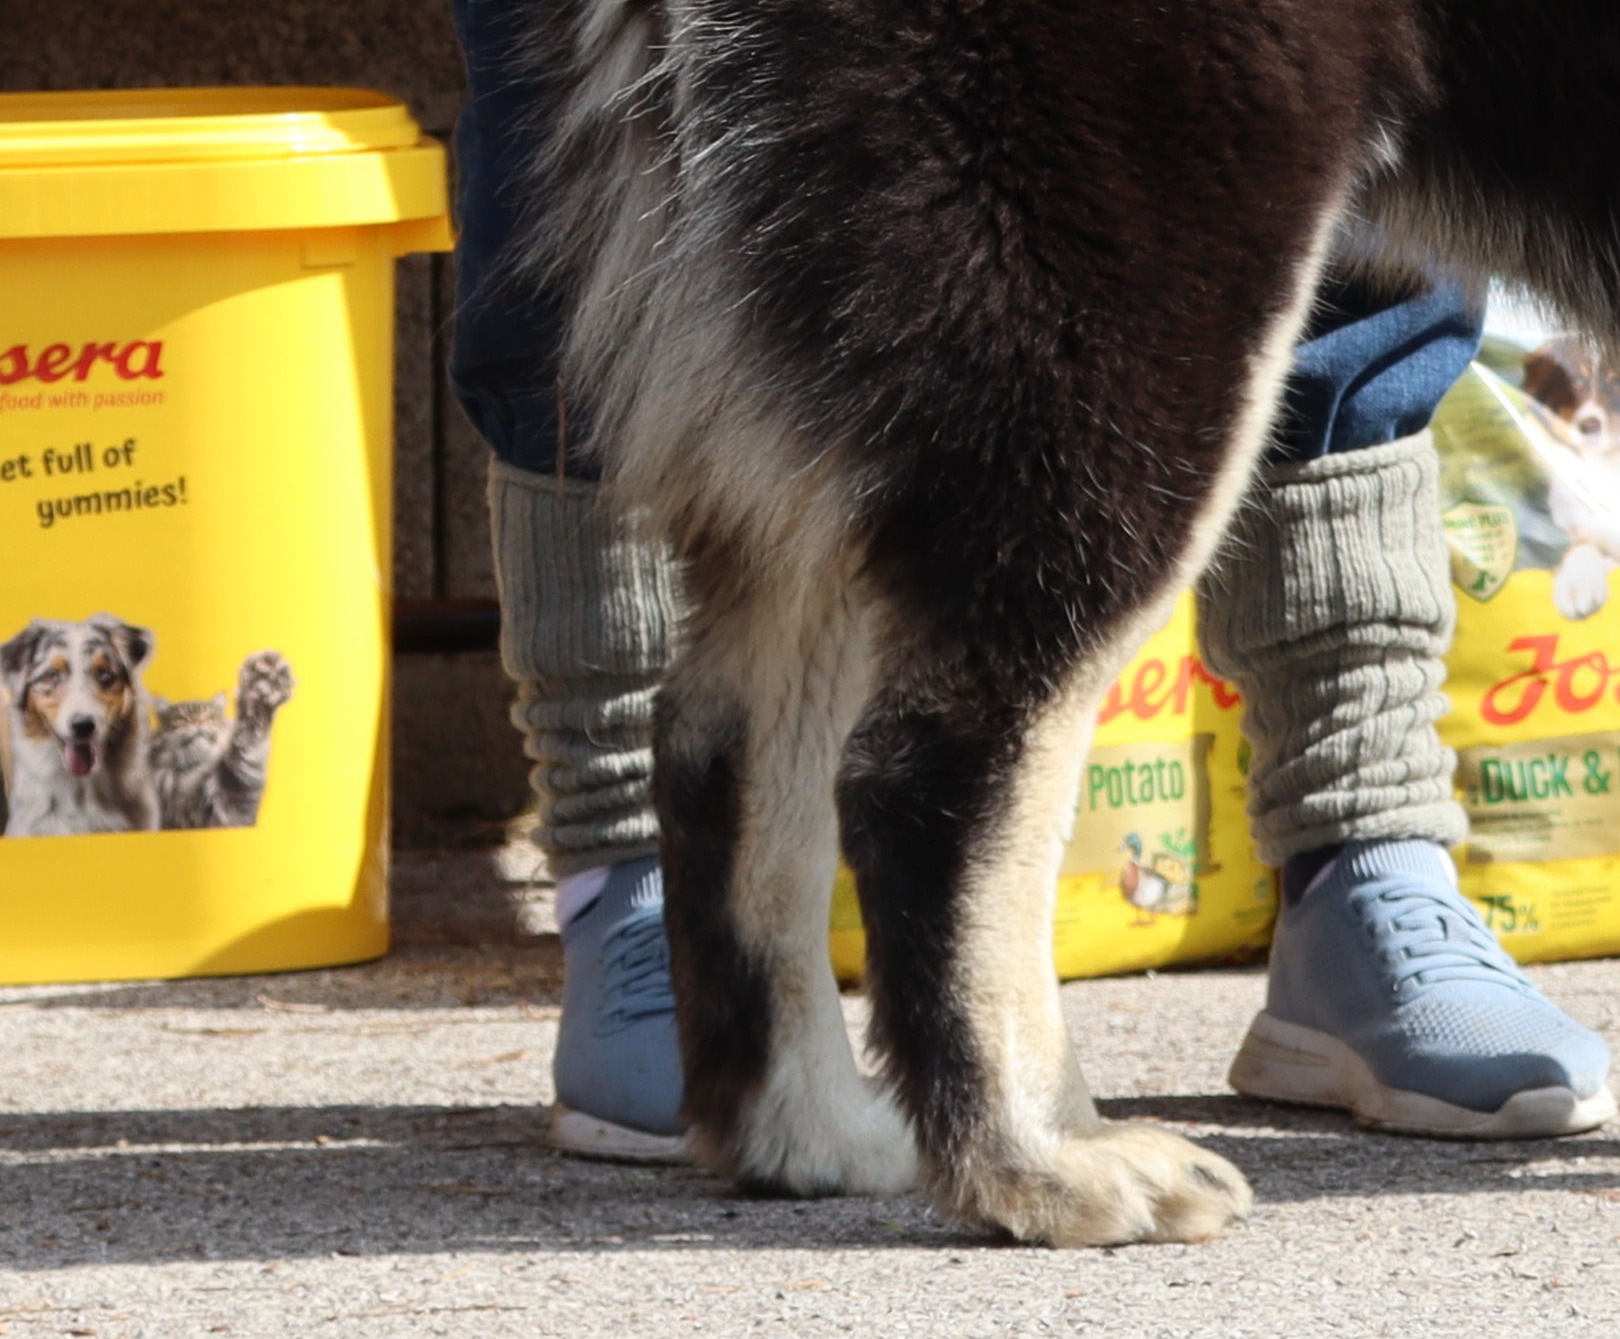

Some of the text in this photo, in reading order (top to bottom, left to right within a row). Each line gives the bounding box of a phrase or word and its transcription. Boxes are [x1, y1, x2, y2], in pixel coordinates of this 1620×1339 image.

[0, 340, 164, 385] sera
[0, 390, 164, 411] food with passion
[42, 442, 95, 477] full
[103, 437, 137, 468] of
[37, 475, 188, 530] yummies!
[1088, 758, 1185, 812] Potato
[1583, 750, 1611, 795] &
[1478, 894, 1540, 933] 75%
